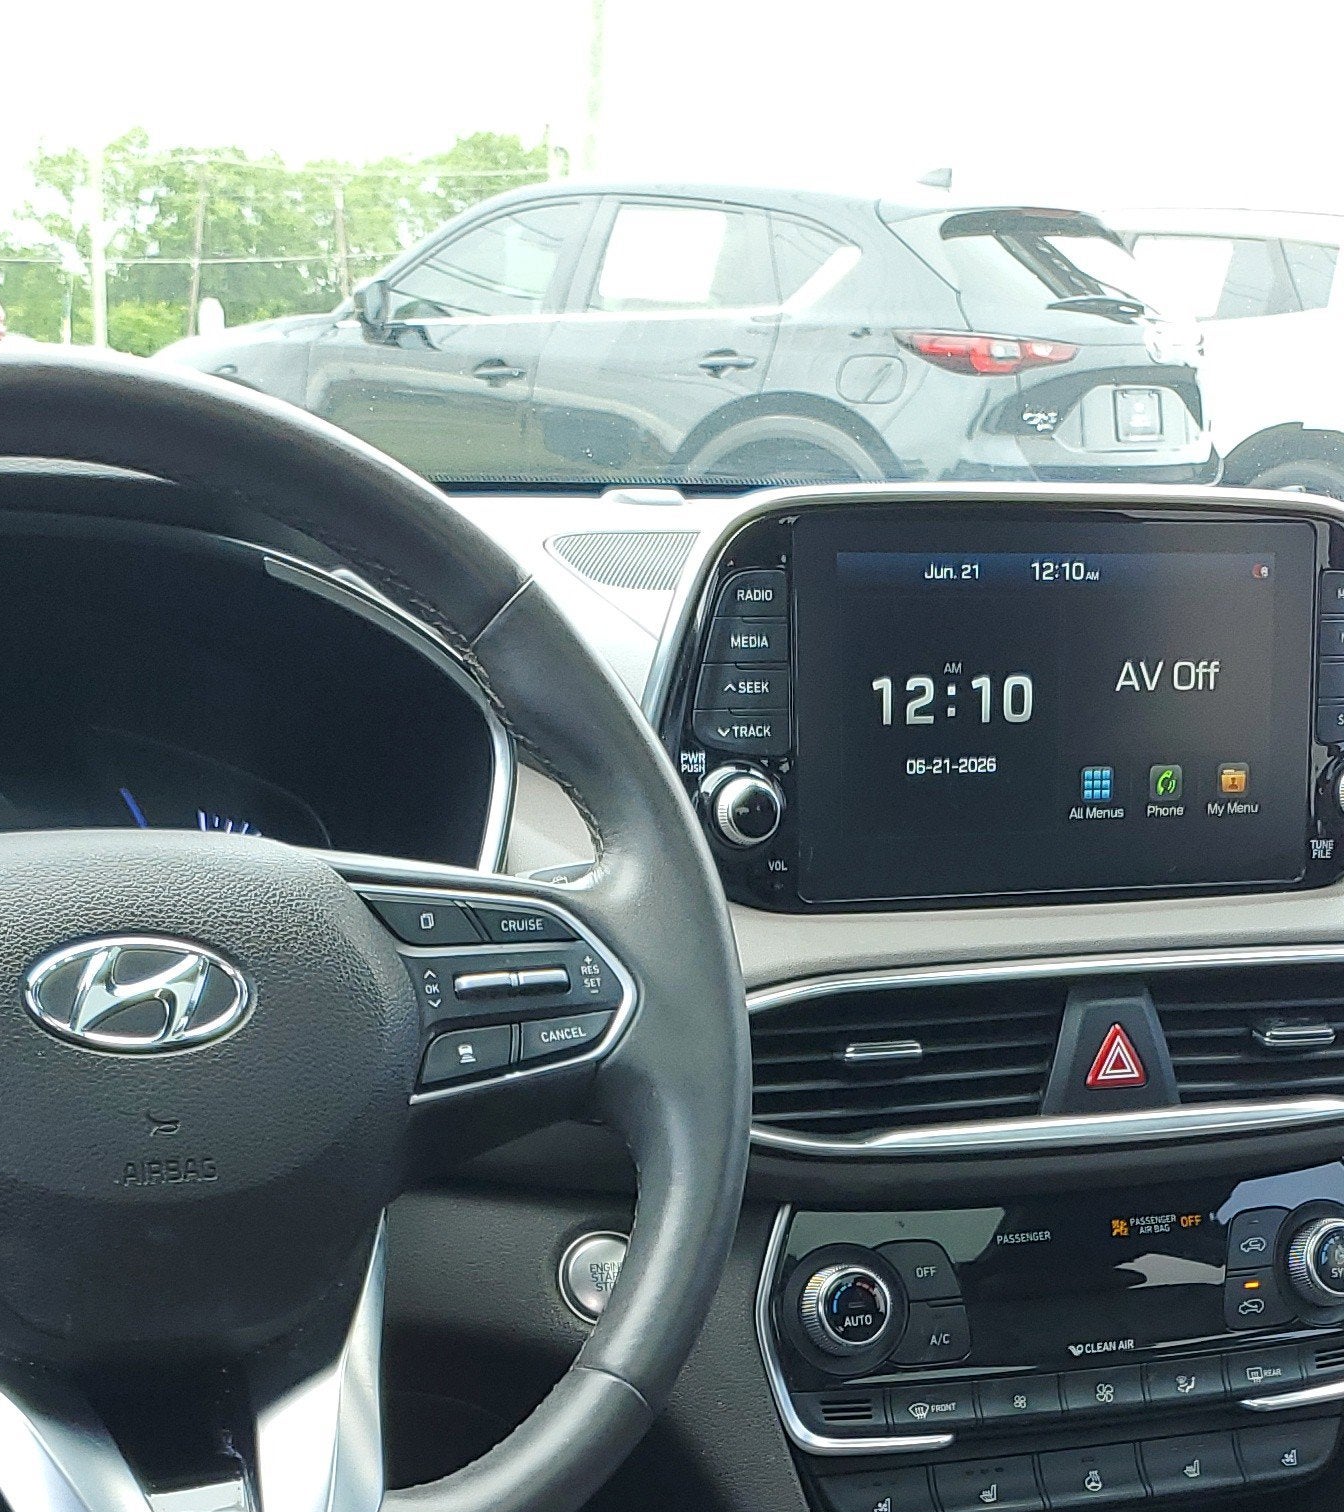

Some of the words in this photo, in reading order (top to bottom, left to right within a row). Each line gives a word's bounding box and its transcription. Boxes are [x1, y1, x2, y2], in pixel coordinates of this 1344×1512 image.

[924, 563, 958, 579] Jun.
[961, 564, 979, 579] 21
[1031, 562, 1084, 581] 12:10
[737, 588, 773, 602] RADIO
[730, 634, 769, 649] MEDIA
[943, 662, 962, 675] AM
[1115, 661, 1164, 692] AV
[1173, 660, 1220, 691] Off
[738, 681, 770, 694] SEEK
[872, 675, 1033, 726] 12:10
[732, 724, 772, 738] TRACK
[680, 751, 705, 764] PWR
[681, 763, 705, 774] PUSH
[906, 757, 997, 775] 06-21-2026
[1069, 807, 1084, 820] All
[1086, 806, 1124, 820] Menus
[1147, 804, 1184, 818] Phone
[1207, 802, 1225, 817] My
[1227, 801, 1258, 815] Menu
[1310, 839, 1334, 850] TUNE
[1312, 849, 1332, 859] FILE
[768, 859, 788, 871] VOL
[501, 918, 544, 933] CRUISE
[581, 965, 600, 976] RES
[425, 984, 440, 995] OK
[583, 977, 601, 988] SET
[540, 1026, 587, 1044] CANCEL
[119, 1157, 219, 1187] AIRBAG
[1130, 1214, 1176, 1227] PASSENGER
[1180, 1214, 1202, 1228] OFF
[1139, 1225, 1153, 1235] AIR
[1154, 1224, 1171, 1233] BAG
[996, 1230, 1051, 1245] PASSENGER
[916, 1266, 937, 1278] OFF
[844, 1314, 872, 1327] AUTO
[929, 1333, 951, 1346] A/C
[1085, 1340, 1117, 1354] CLEAN
[1118, 1339, 1135, 1350] AIR
[931, 1402, 956, 1413] FRONT
